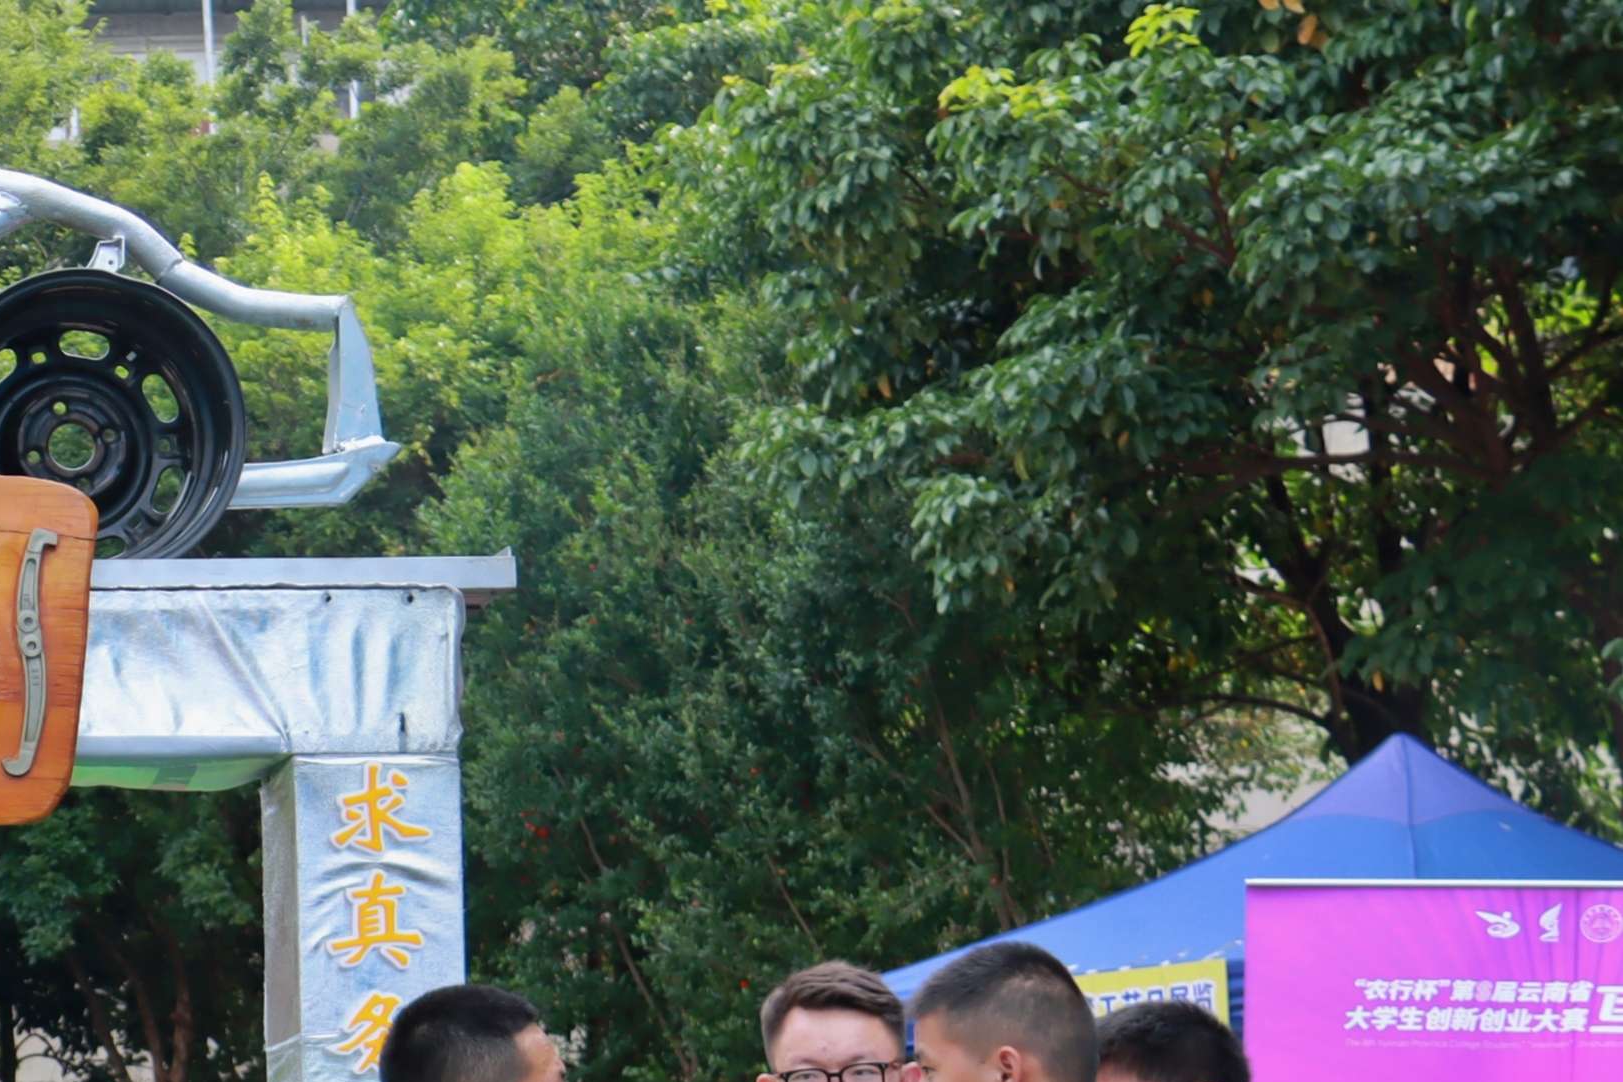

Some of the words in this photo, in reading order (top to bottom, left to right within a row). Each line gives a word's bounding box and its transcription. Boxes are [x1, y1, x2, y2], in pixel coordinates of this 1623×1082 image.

[1344, 1007, 1589, 1032] 大学生创新创业大赛
